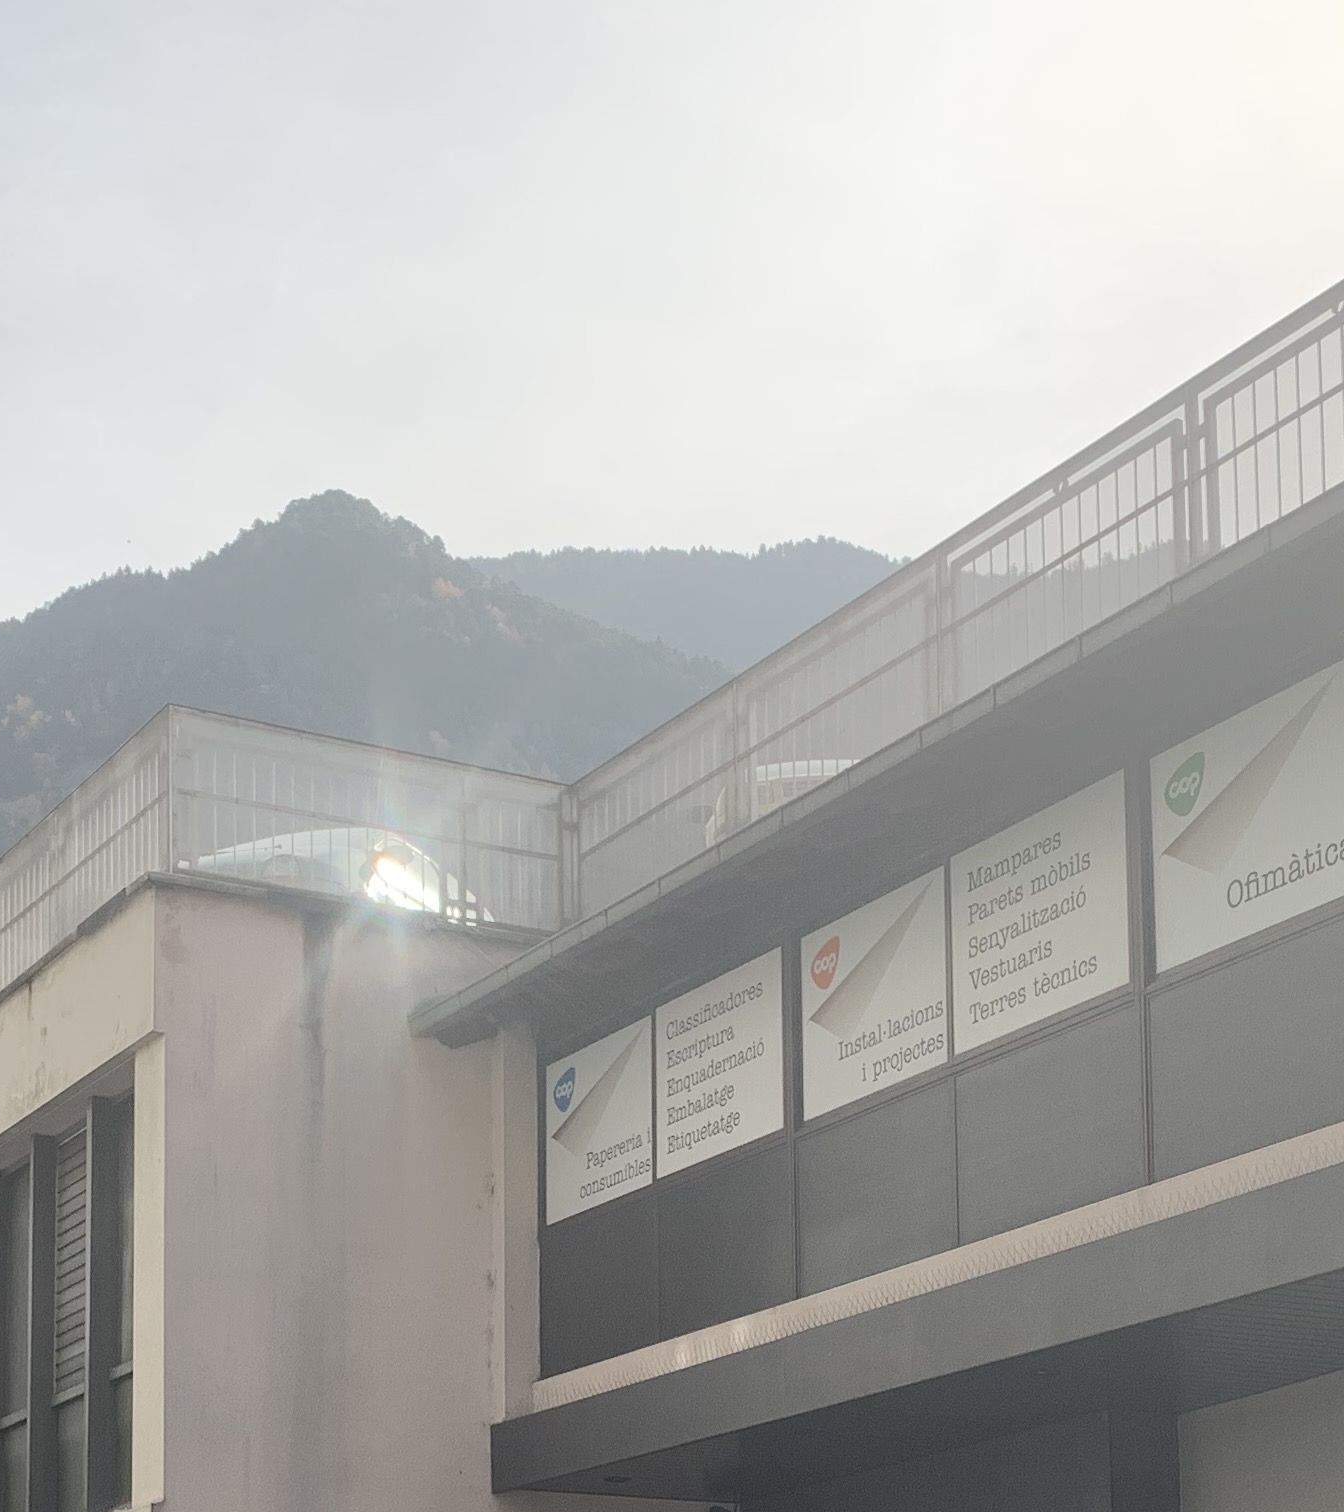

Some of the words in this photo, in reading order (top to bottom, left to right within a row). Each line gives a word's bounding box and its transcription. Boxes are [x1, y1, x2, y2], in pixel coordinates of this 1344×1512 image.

[1169, 771, 1200, 799] cop
[967, 831, 1062, 893] Mampares
[968, 885, 1024, 926] Parets
[1031, 851, 1092, 897] mòbils
[968, 884, 1087, 960] Senyalització
[813, 952, 836, 975] cop
[969, 940, 1053, 991] Vestuaris
[666, 981, 763, 1041] Classificadores
[969, 986, 1027, 1025] Terres
[1033, 955, 1098, 997] tècnics
[666, 1024, 735, 1070] Escriptura
[838, 1000, 944, 1061] Instal·lacions
[666, 1037, 765, 1098] Enquadernació
[862, 1063, 867, 1082] i
[873, 1033, 944, 1082] projectes
[666, 1083, 735, 1126] Embalatge
[586, 1135, 643, 1170] Papereria
[647, 1126, 653, 1145] i
[666, 1110, 740, 1155] Etiquetatge
[579, 1158, 652, 1200] consumibles
